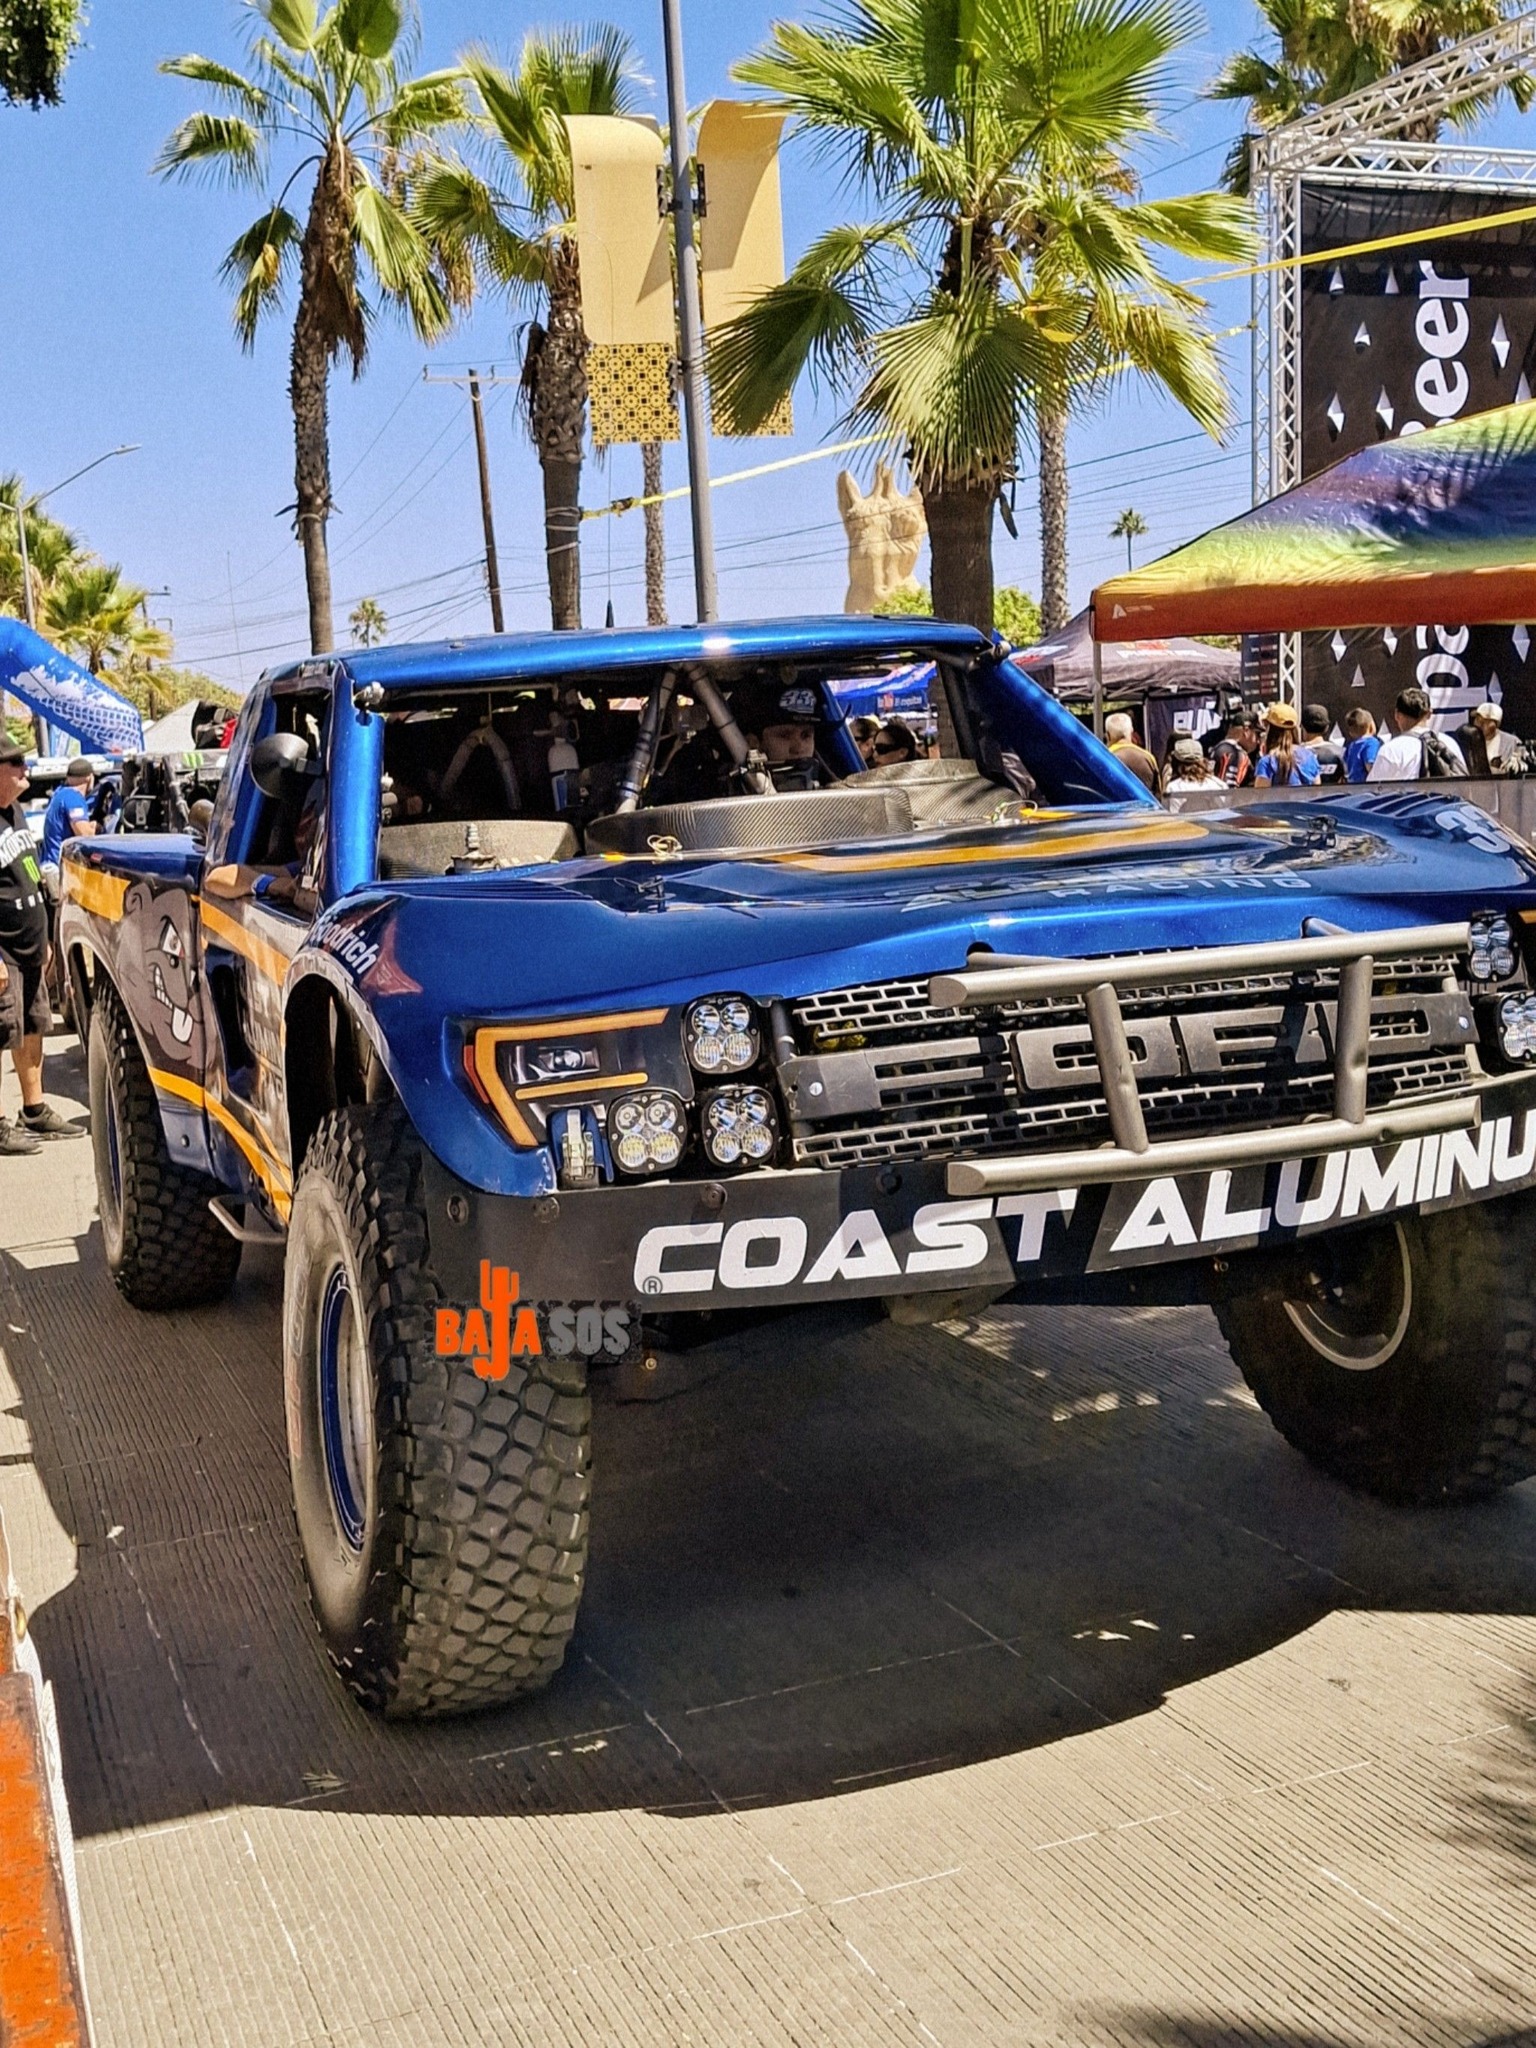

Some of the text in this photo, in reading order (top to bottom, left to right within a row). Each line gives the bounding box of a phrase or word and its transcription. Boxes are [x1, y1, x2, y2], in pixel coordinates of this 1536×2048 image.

[1402, 260, 1469, 436] eer
[1048, 878, 1312, 898] RACING
[634, 1110, 1536, 1294] COAST ALUMINU
